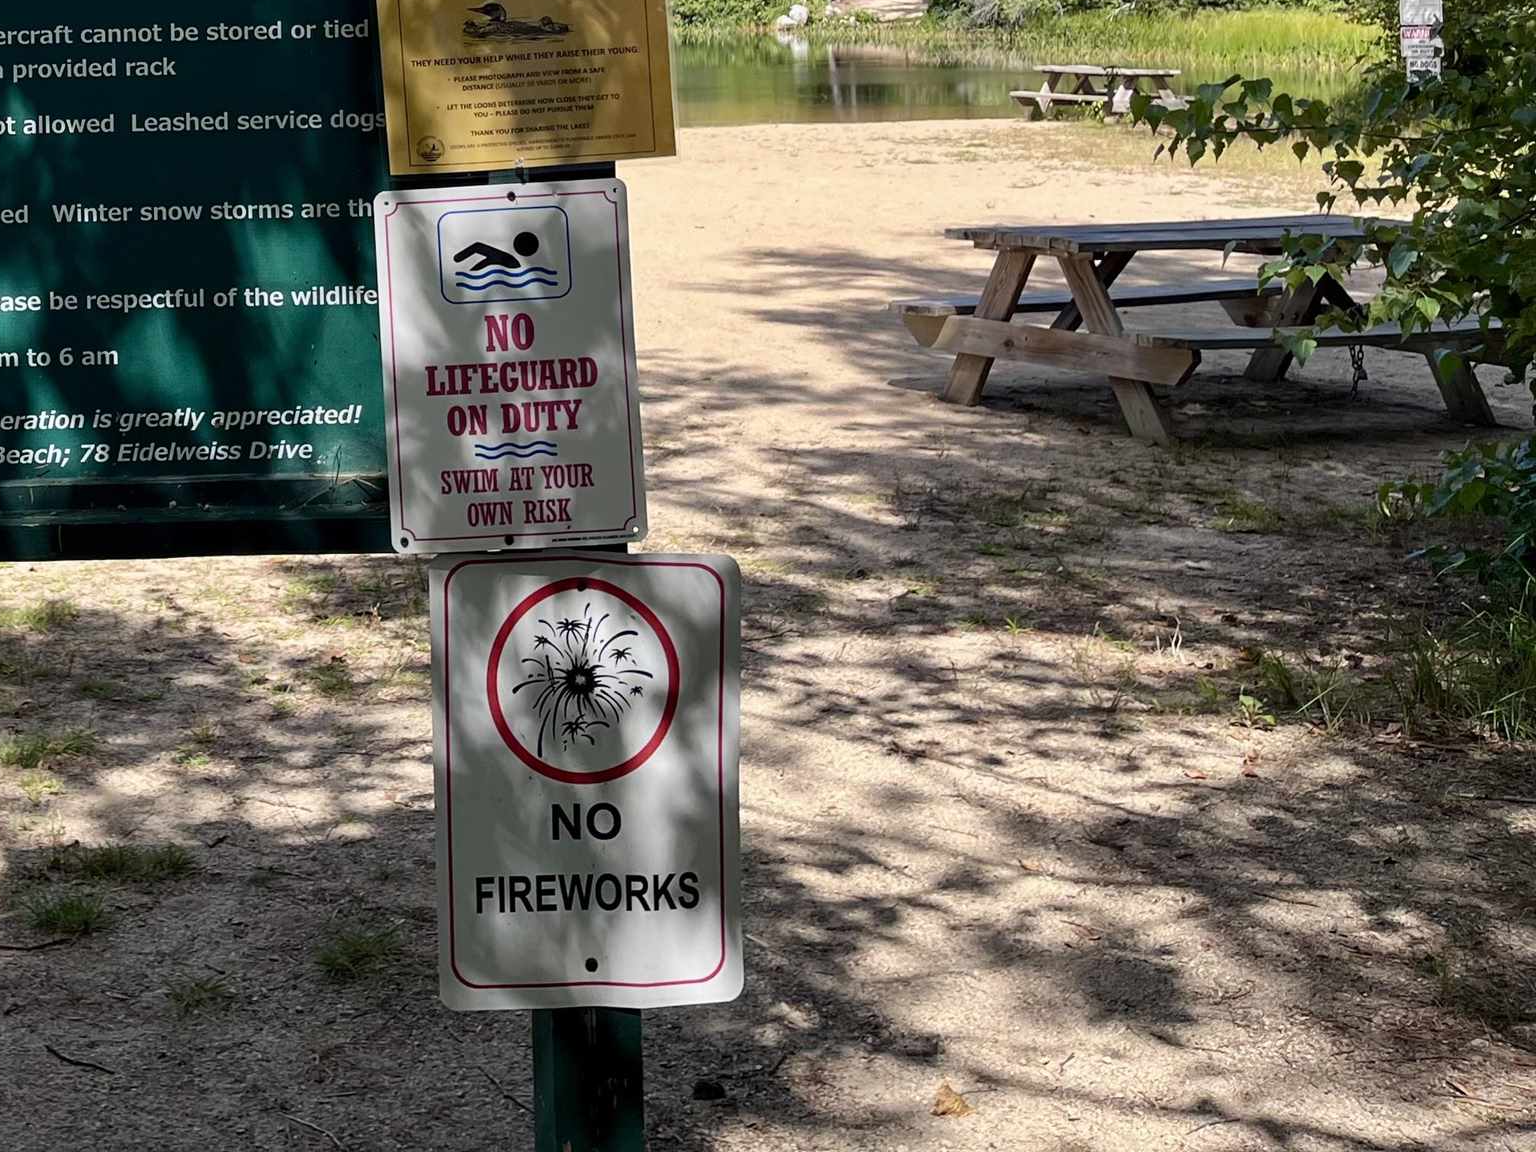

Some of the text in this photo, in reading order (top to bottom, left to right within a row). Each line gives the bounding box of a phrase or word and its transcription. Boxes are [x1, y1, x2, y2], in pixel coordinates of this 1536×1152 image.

[22, 112, 114, 135] allowed
[130, 110, 229, 132] Leashed
[236, 109, 322, 130] service
[48, 290, 78, 310] be
[85, 287, 204, 313] respectful
[212, 286, 238, 307] of
[242, 286, 284, 307] the
[290, 284, 377, 306] wildlife
[484, 312, 535, 353] NO
[25, 347, 51, 367] to
[58, 346, 74, 366] 6
[80, 349, 119, 366] am
[425, 356, 599, 397] LIFEGUARD
[91, 408, 112, 428] is
[118, 406, 206, 432] greatly
[209, 405, 361, 429] appreciated!
[447, 398, 583, 437] ON DUTY
[79, 442, 110, 463] 78
[116, 439, 242, 462] Eidelweiss
[248, 438, 313, 460] Drive
[440, 462, 595, 495] SWIM AT YOUR
[467, 497, 572, 527] OWN RISK
[551, 802, 622, 841] NO
[475, 871, 700, 914] FIREWORKS
